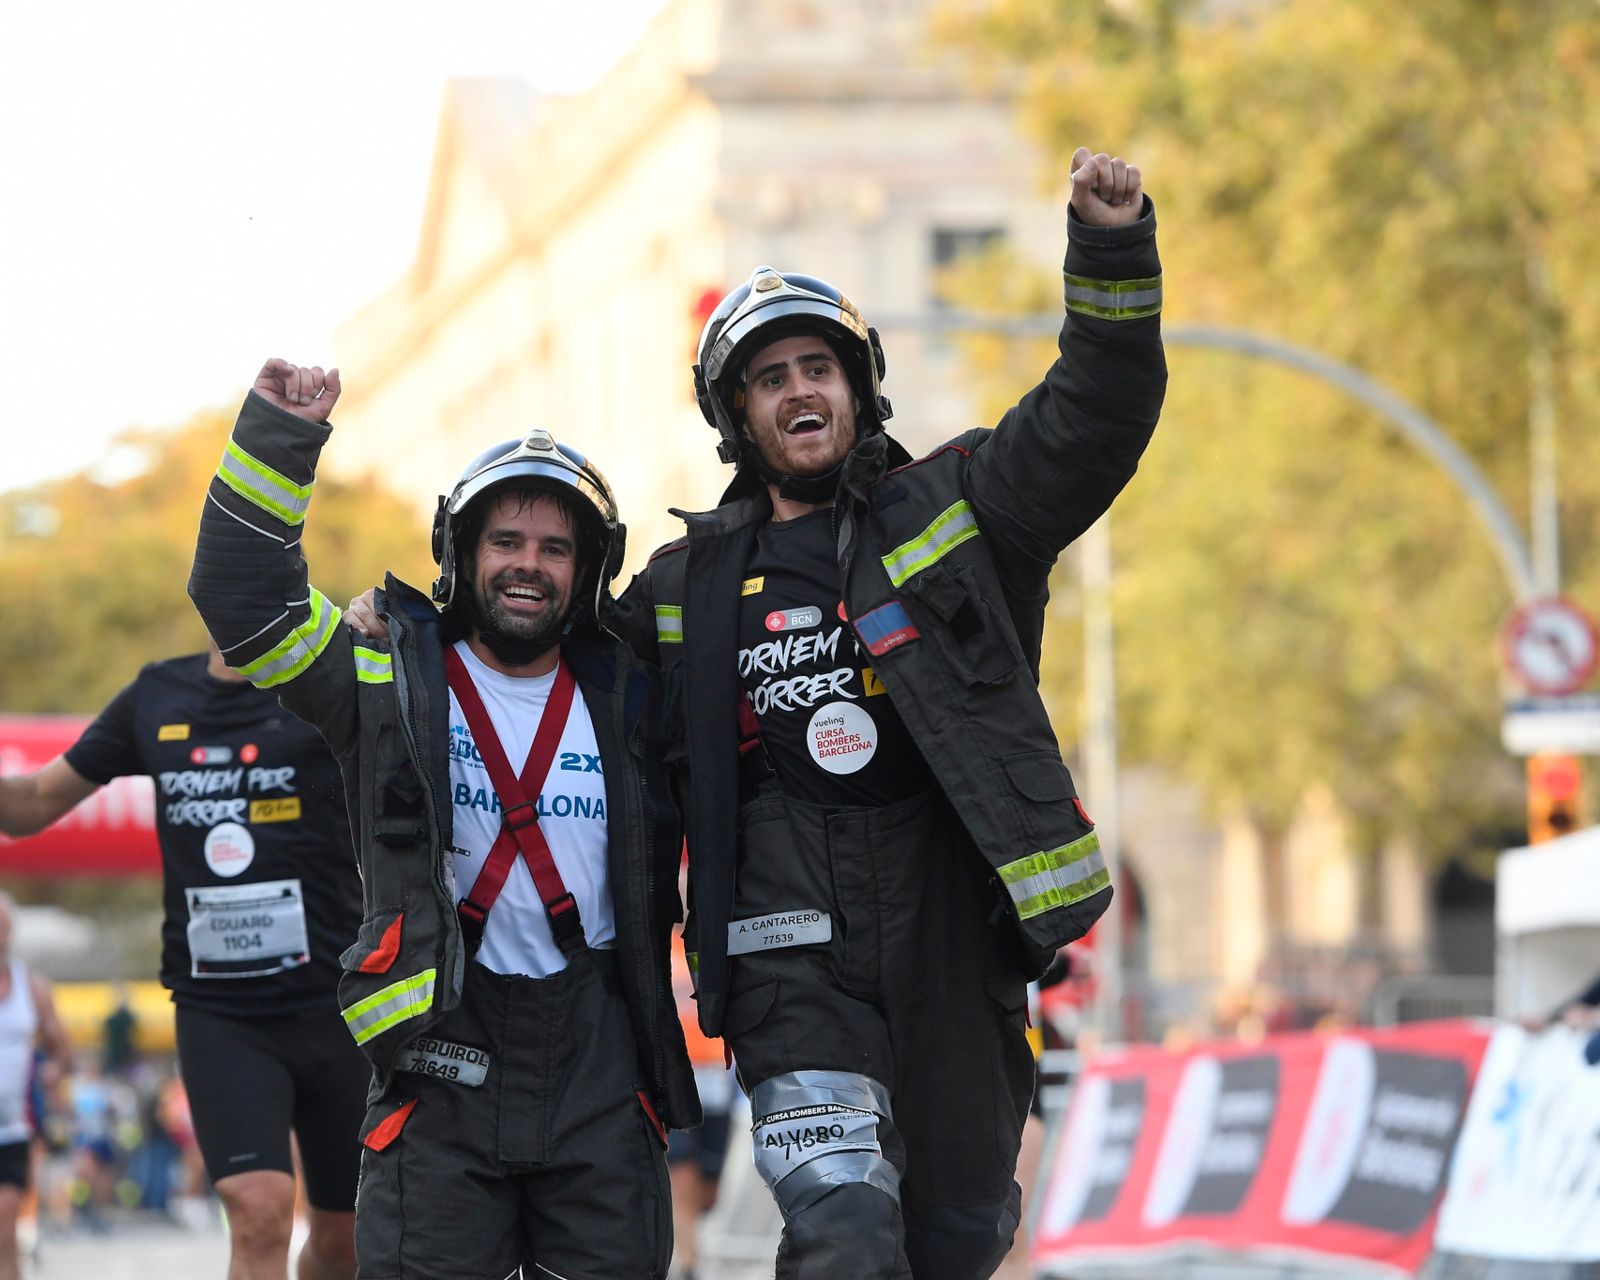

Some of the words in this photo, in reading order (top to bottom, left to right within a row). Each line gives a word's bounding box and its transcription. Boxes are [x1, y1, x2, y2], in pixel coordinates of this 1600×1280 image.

[791, 615, 813, 625] BCN
[738, 626, 842, 678] ORNEM
[747, 667, 859, 716] ÓRRER
[813, 716, 845, 728] vueling
[815, 727, 845, 740] CURSA
[817, 733, 860, 749] BOMBERS
[819, 740, 873, 758] BARCELONA
[159, 768, 244, 797] TORNEM
[247, 766, 296, 792] PER
[454, 783, 605, 820] BARLONA
[210, 913, 274, 932] EDUARD
[739, 925, 749, 934] A.
[752, 912, 820, 931] CANTARERO
[223, 932, 263, 951] 1104
[763, 933, 794, 945] 77539
[408, 1039, 489, 1067] ESQUIROL
[410, 1058, 460, 1080] 73649
[766, 1111, 789, 1123] CURSA
[789, 1106, 827, 1119] BOMBERS
[765, 1124, 844, 1149] ALVARO
